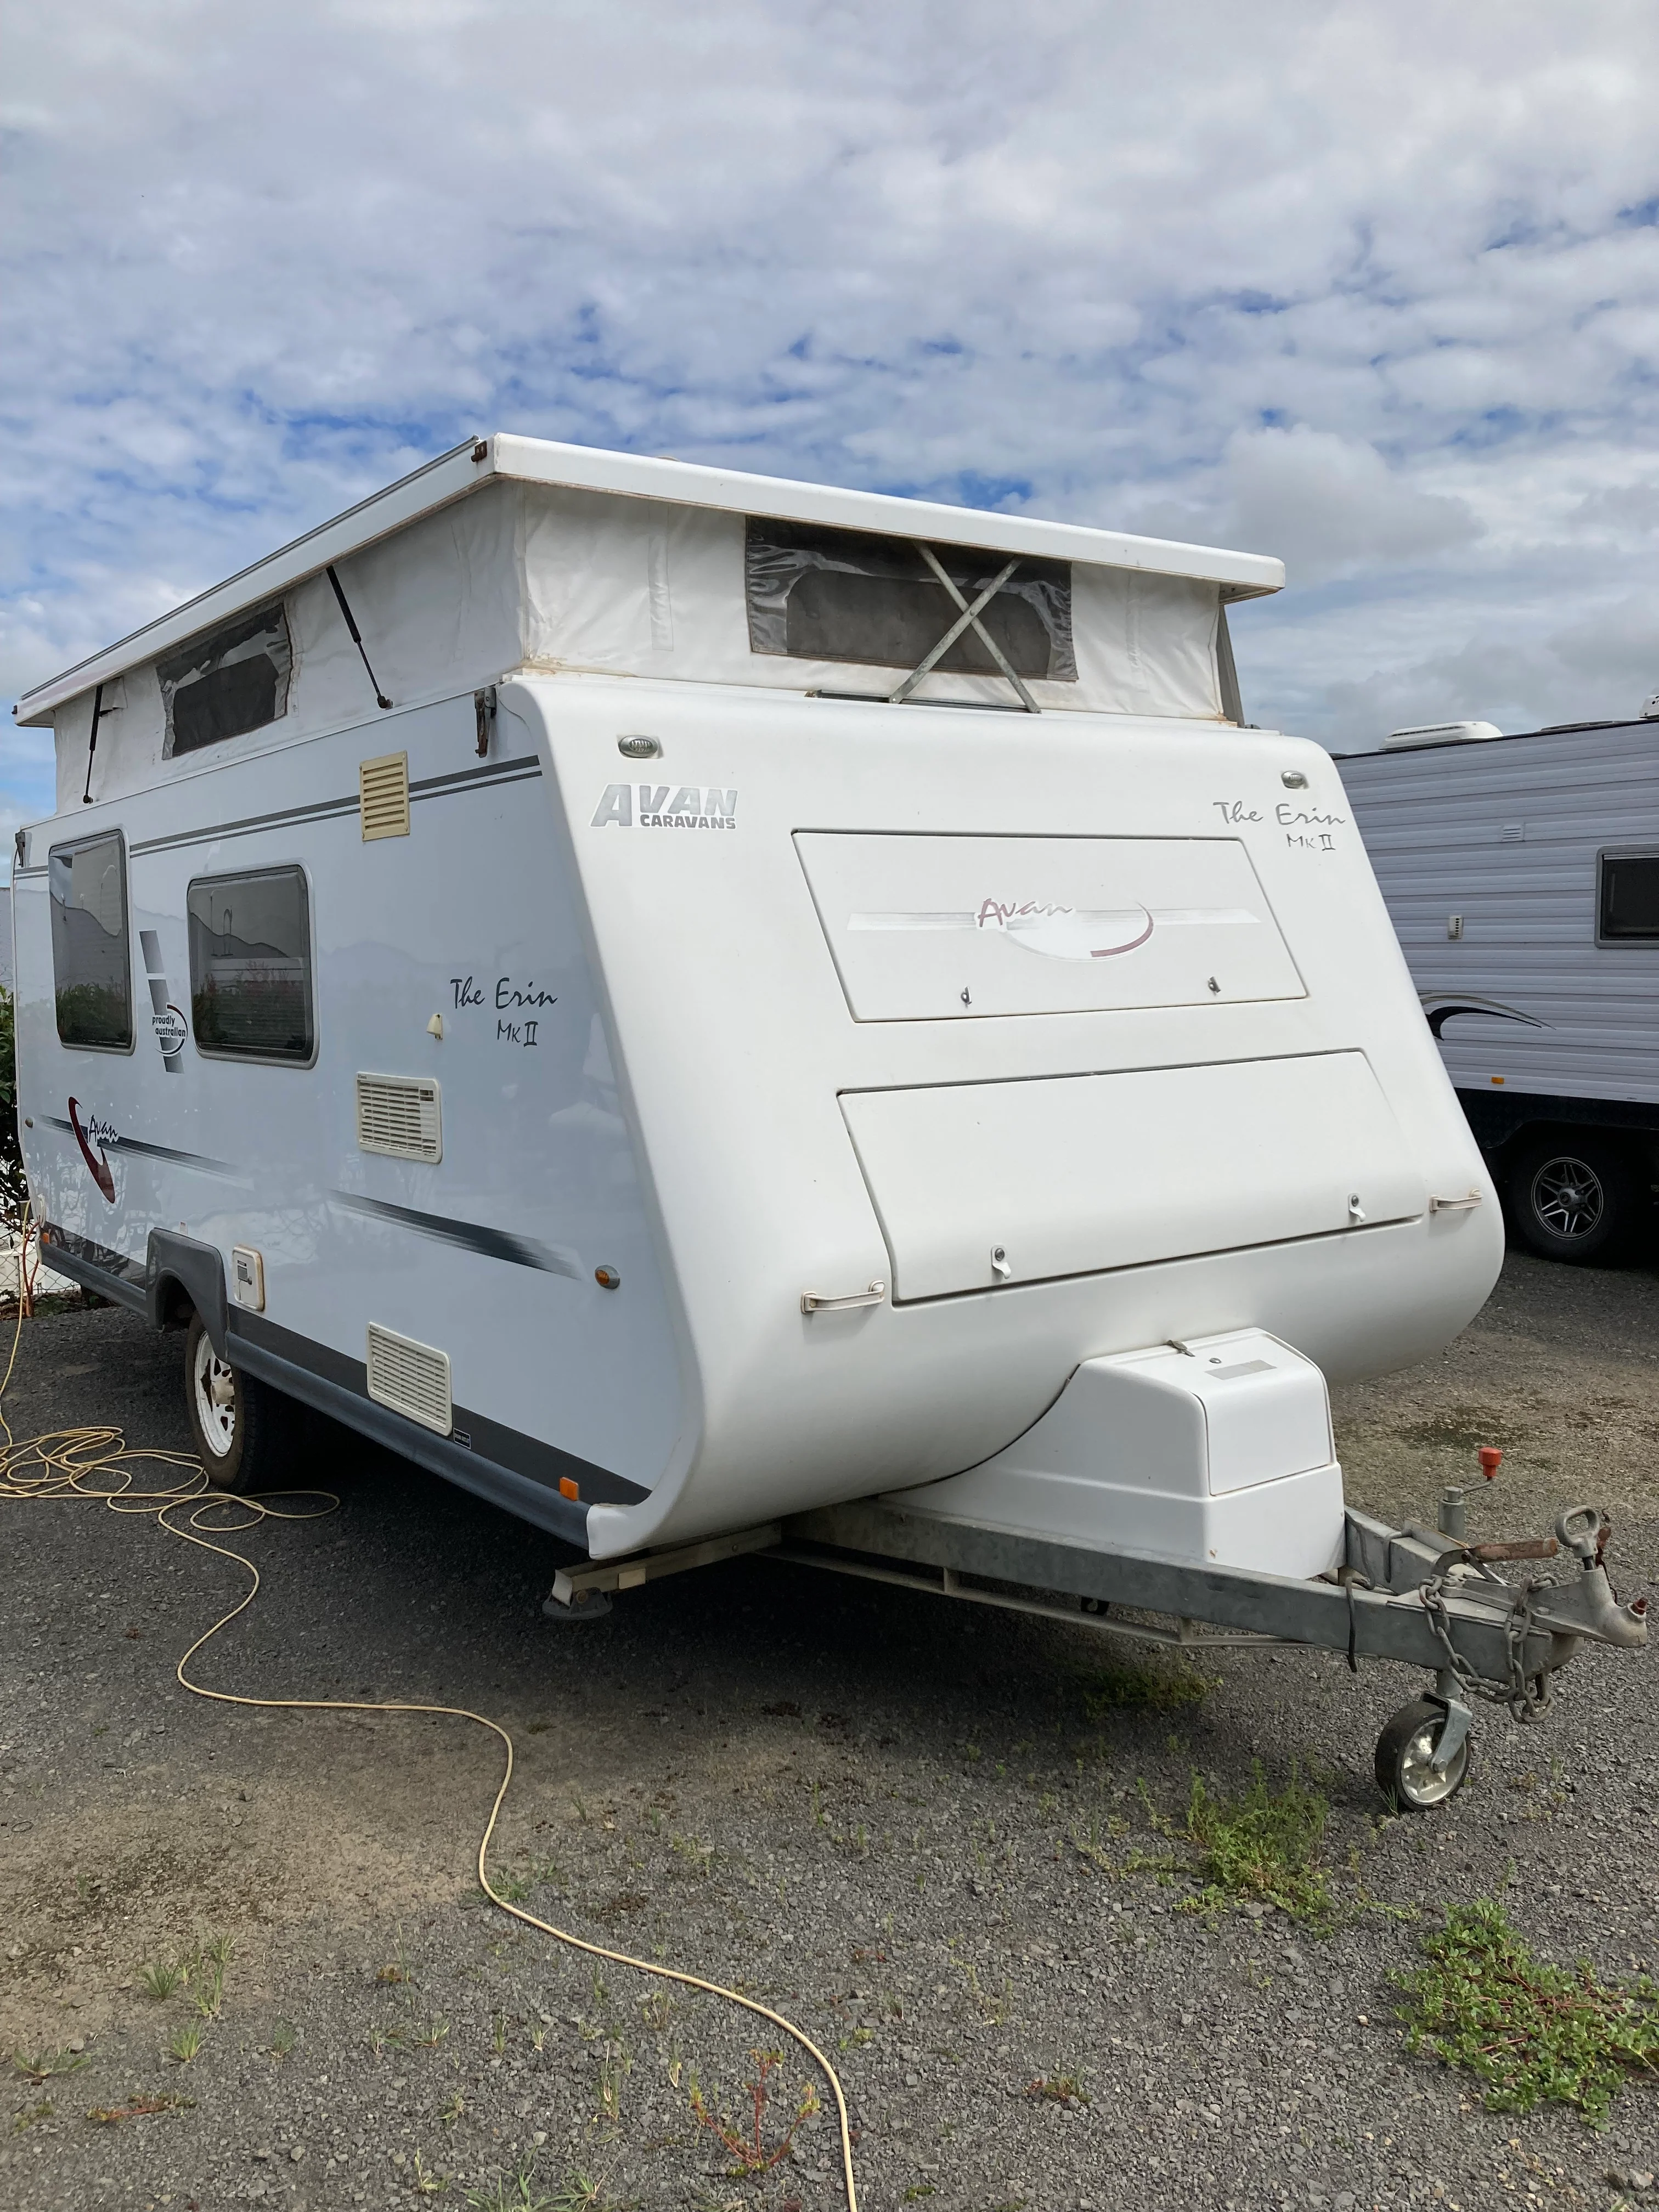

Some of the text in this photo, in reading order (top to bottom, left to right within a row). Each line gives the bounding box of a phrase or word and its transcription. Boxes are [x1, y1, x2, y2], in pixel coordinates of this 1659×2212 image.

[590, 784, 738, 827] AVAN
[1212, 800, 1346, 826] The Erin
[640, 814, 736, 830] CARAVANS
[977, 898, 1073, 928] Avan
[450, 976, 558, 1009] The Erin
[152, 1015, 176, 1027] proudly
[155, 1026, 186, 1037] australian
[88, 1114, 118, 1143] Avan
